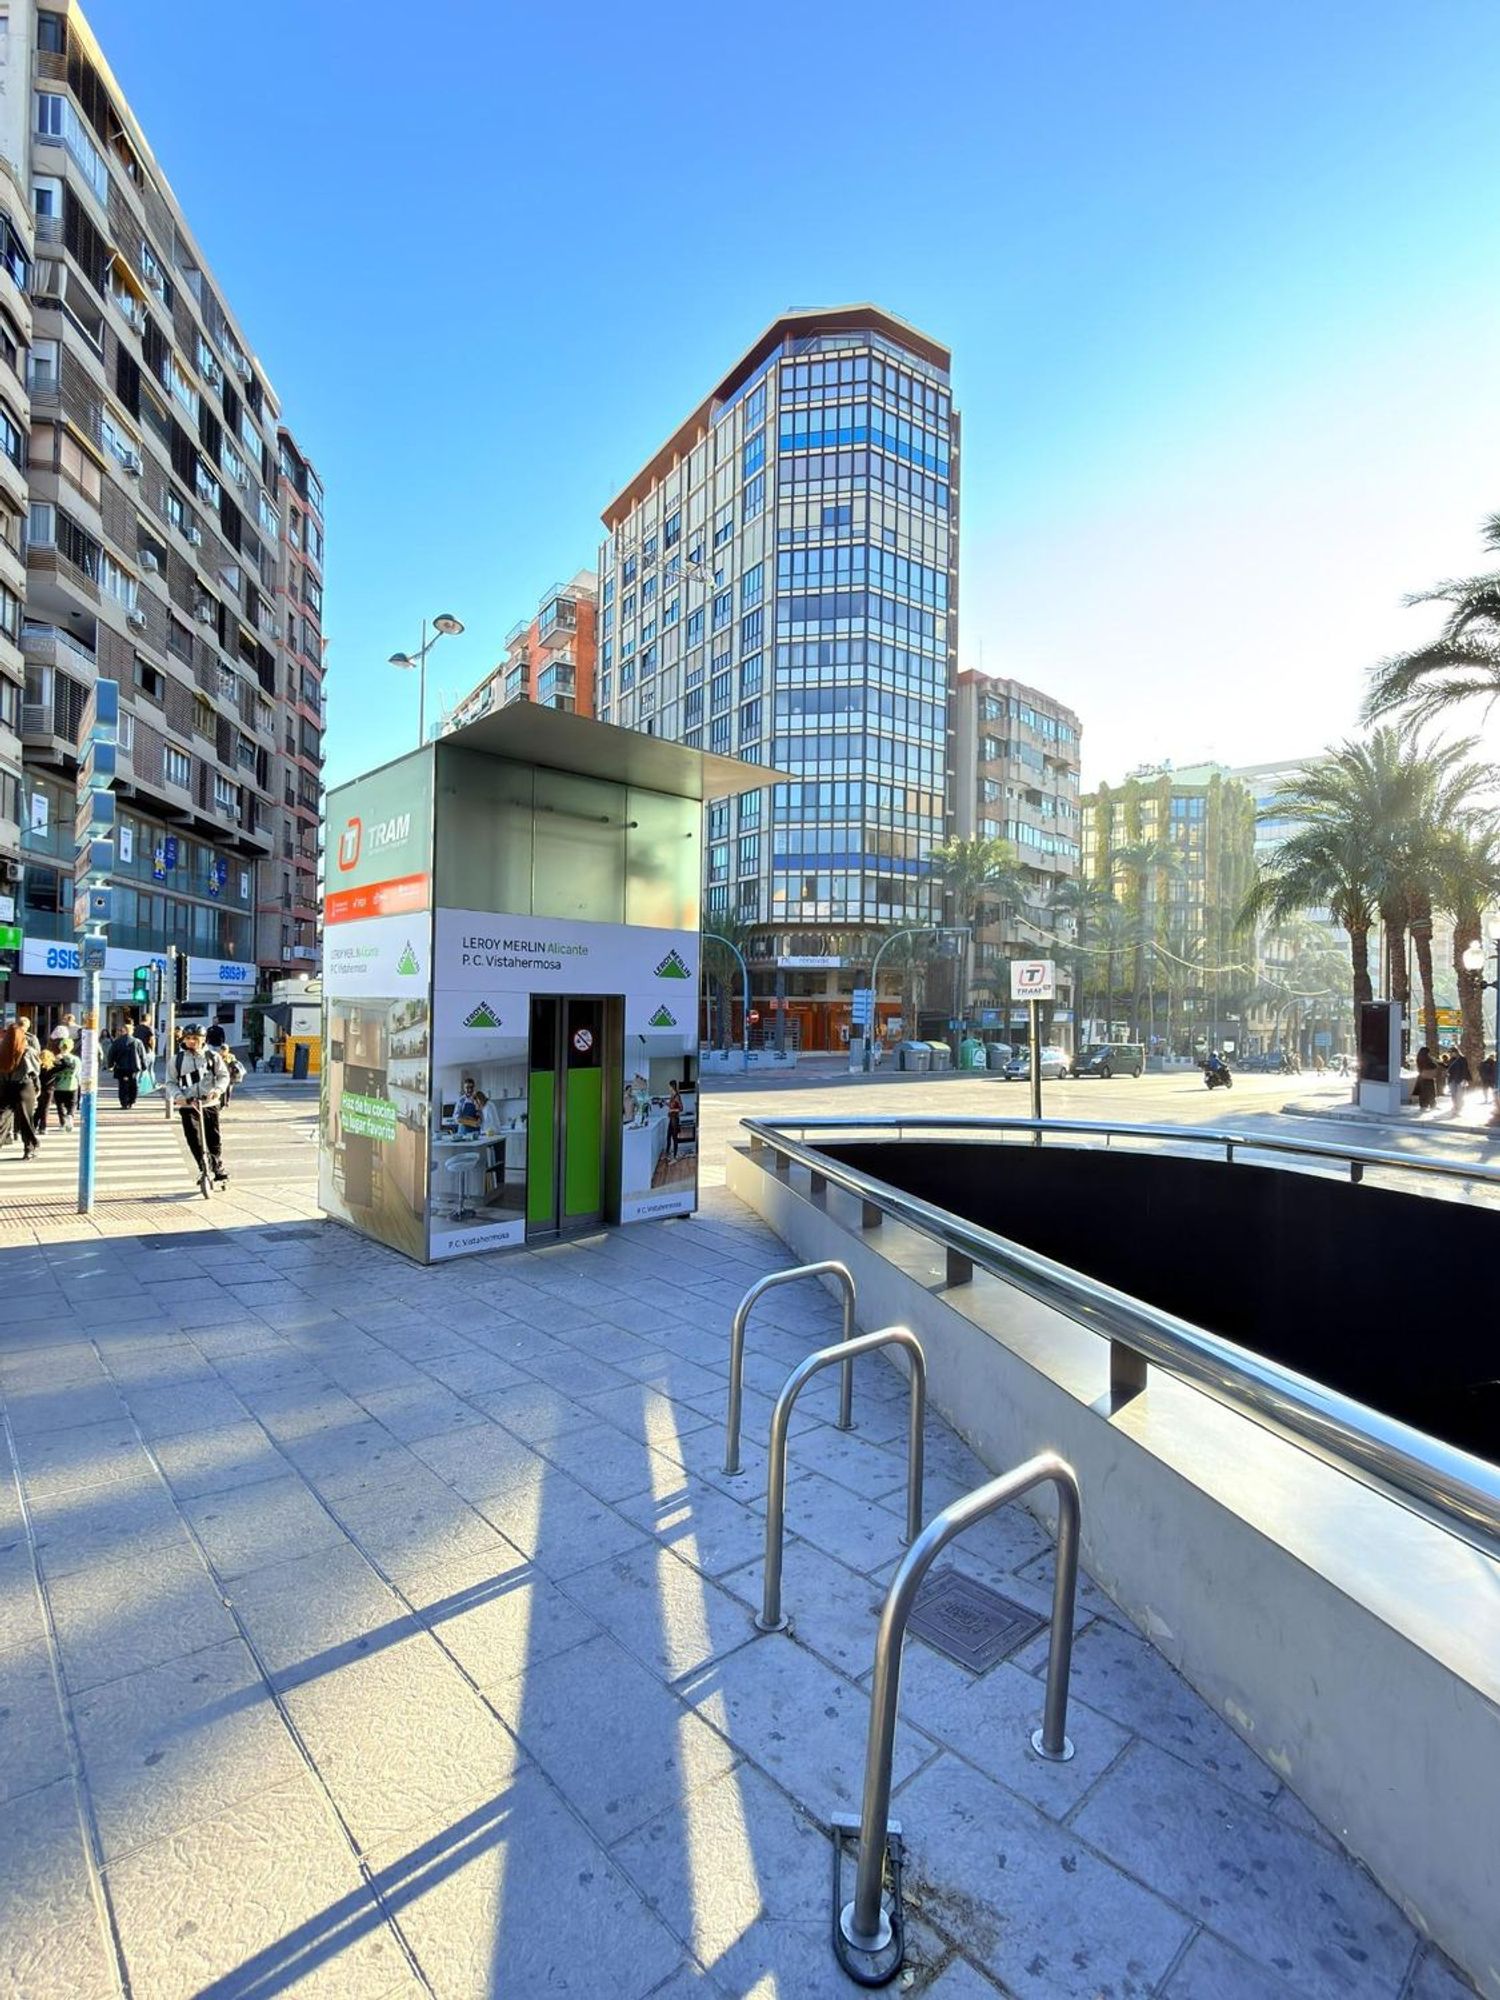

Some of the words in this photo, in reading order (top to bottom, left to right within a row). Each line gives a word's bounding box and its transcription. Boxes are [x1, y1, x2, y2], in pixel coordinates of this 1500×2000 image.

[368, 813, 411, 848] TRAM
[462, 937, 500, 950] LEROY
[503, 939, 545, 953] MERLIN
[547, 943, 588, 956] Alicante
[47, 948, 80, 970] asis
[485, 955, 561, 970] Vistahermosa
[462, 1006, 483, 1027] LEROY
[481, 1001, 503, 1027] MERLIN
[372, 1103, 396, 1120] cocina
[350, 1114, 366, 1134] lugar
[367, 1119, 396, 1140] favorito
[463, 1231, 510, 1246] Vistahermosa
